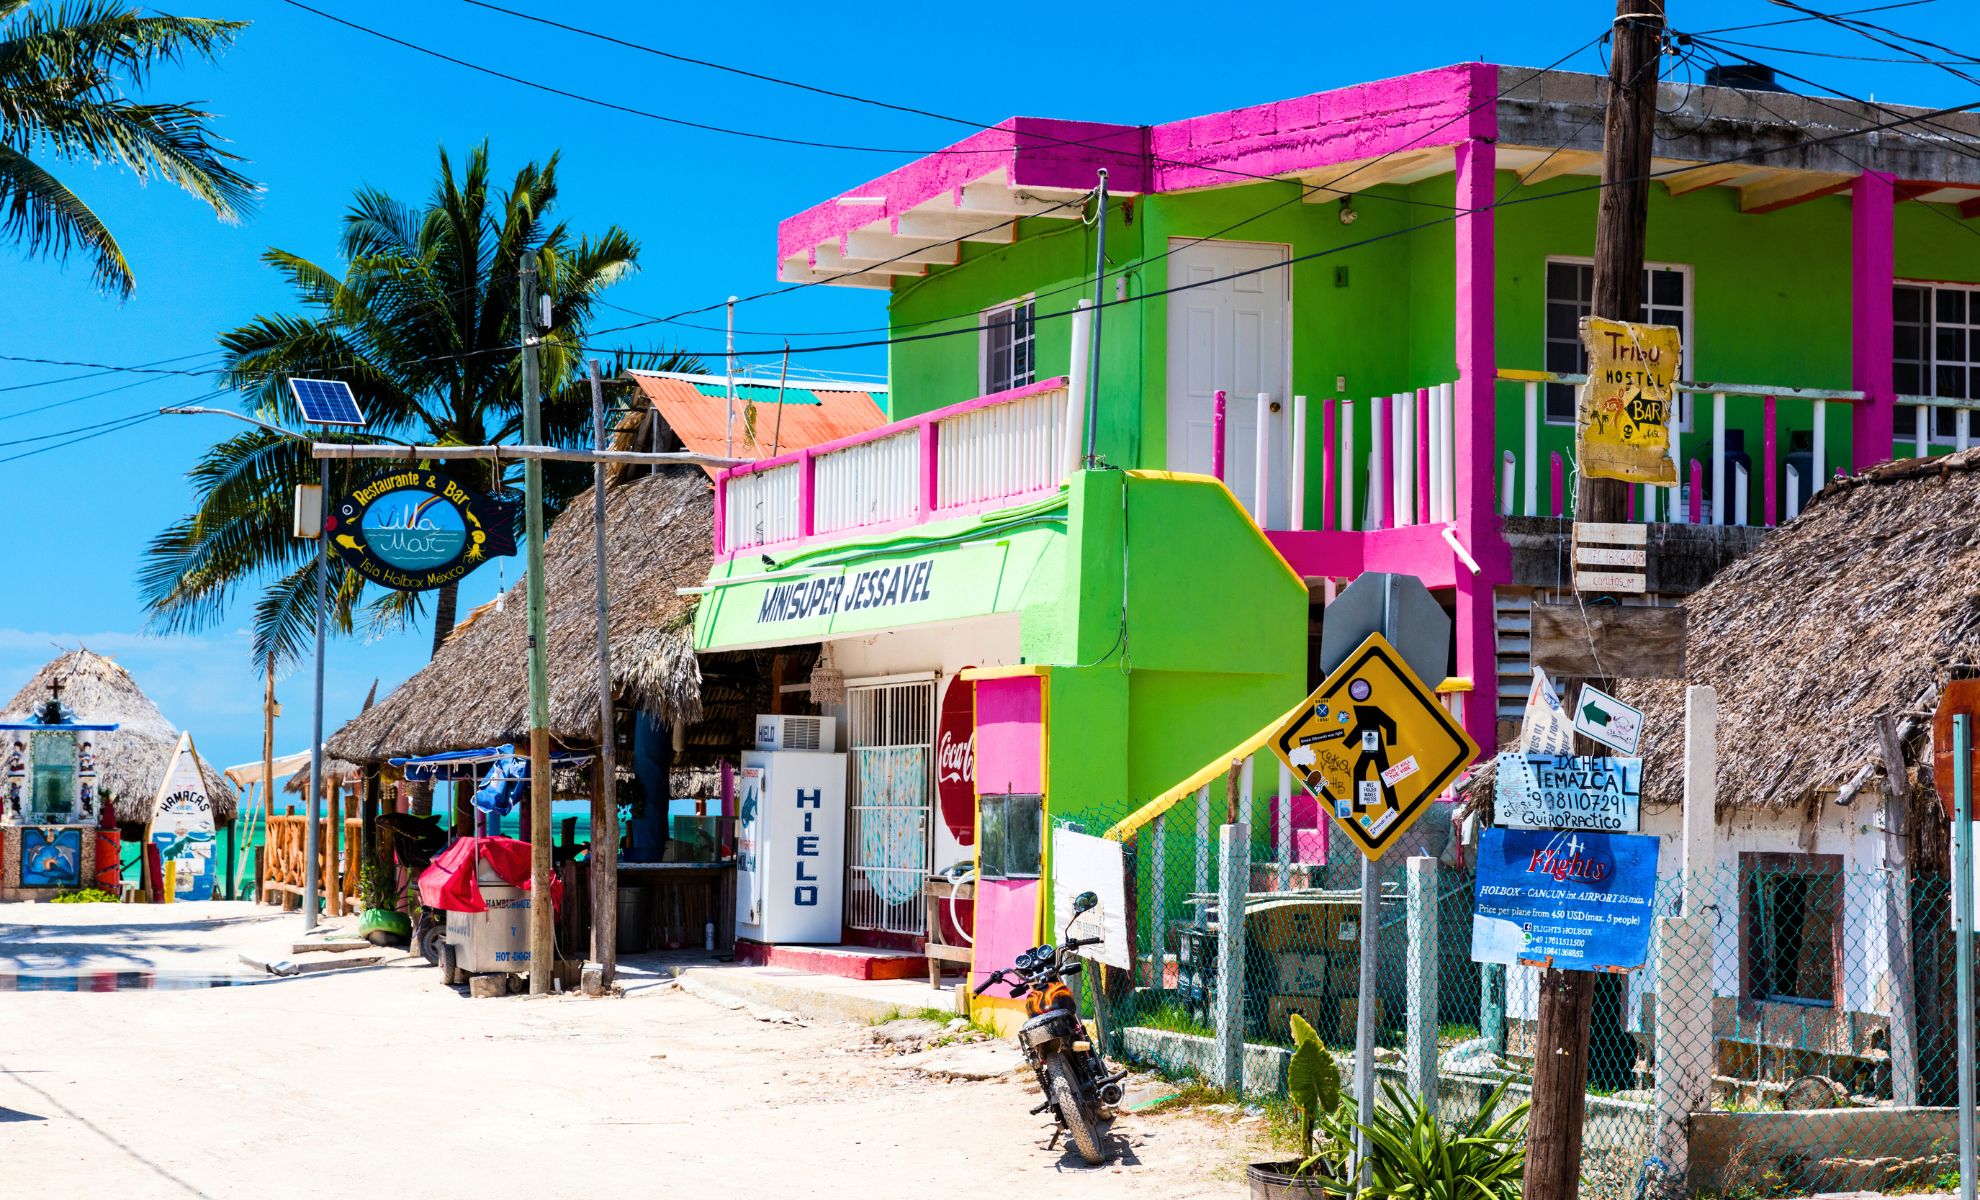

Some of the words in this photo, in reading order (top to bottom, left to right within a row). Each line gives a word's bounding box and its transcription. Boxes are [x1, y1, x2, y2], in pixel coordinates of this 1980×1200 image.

[1606, 369, 1664, 388] HOSTEL
[1632, 400, 1661, 422] BAR
[352, 471, 419, 506] Restaurante
[426, 475, 436, 488] &
[443, 480, 470, 505] Bar
[377, 503, 440, 531] Villa
[381, 532, 445, 553] Mar
[360, 557, 381, 577] Isla
[383, 569, 424, 587] Holbox
[757, 576, 844, 624] MINISUPER
[844, 560, 933, 611] JESSAVEL
[758, 725, 775, 743] HIELO
[1528, 760, 1639, 796] TEMAZCAL
[160, 791, 210, 812] HAMACAS
[794, 788, 821, 906] HIELO
[1526, 850, 1606, 882] Flights
[1481, 885, 1520, 897] HOLBOX
[1527, 888, 1566, 899] CANCUN
[1577, 891, 1619, 903] AIRPORT
[1478, 903, 1497, 914] Price
[1498, 908, 1510, 916] per
[1511, 907, 1531, 917] plane
[1532, 908, 1550, 918] from
[1551, 910, 1565, 919] 450
[1567, 911, 1585, 920] USD
[1585, 912, 1605, 922] (max.
[1606, 914, 1613, 923] 5
[1613, 915, 1640, 926] people)
[1533, 925, 1562, 934] FLIGHTS
[1562, 927, 1593, 936] HOLBOX
